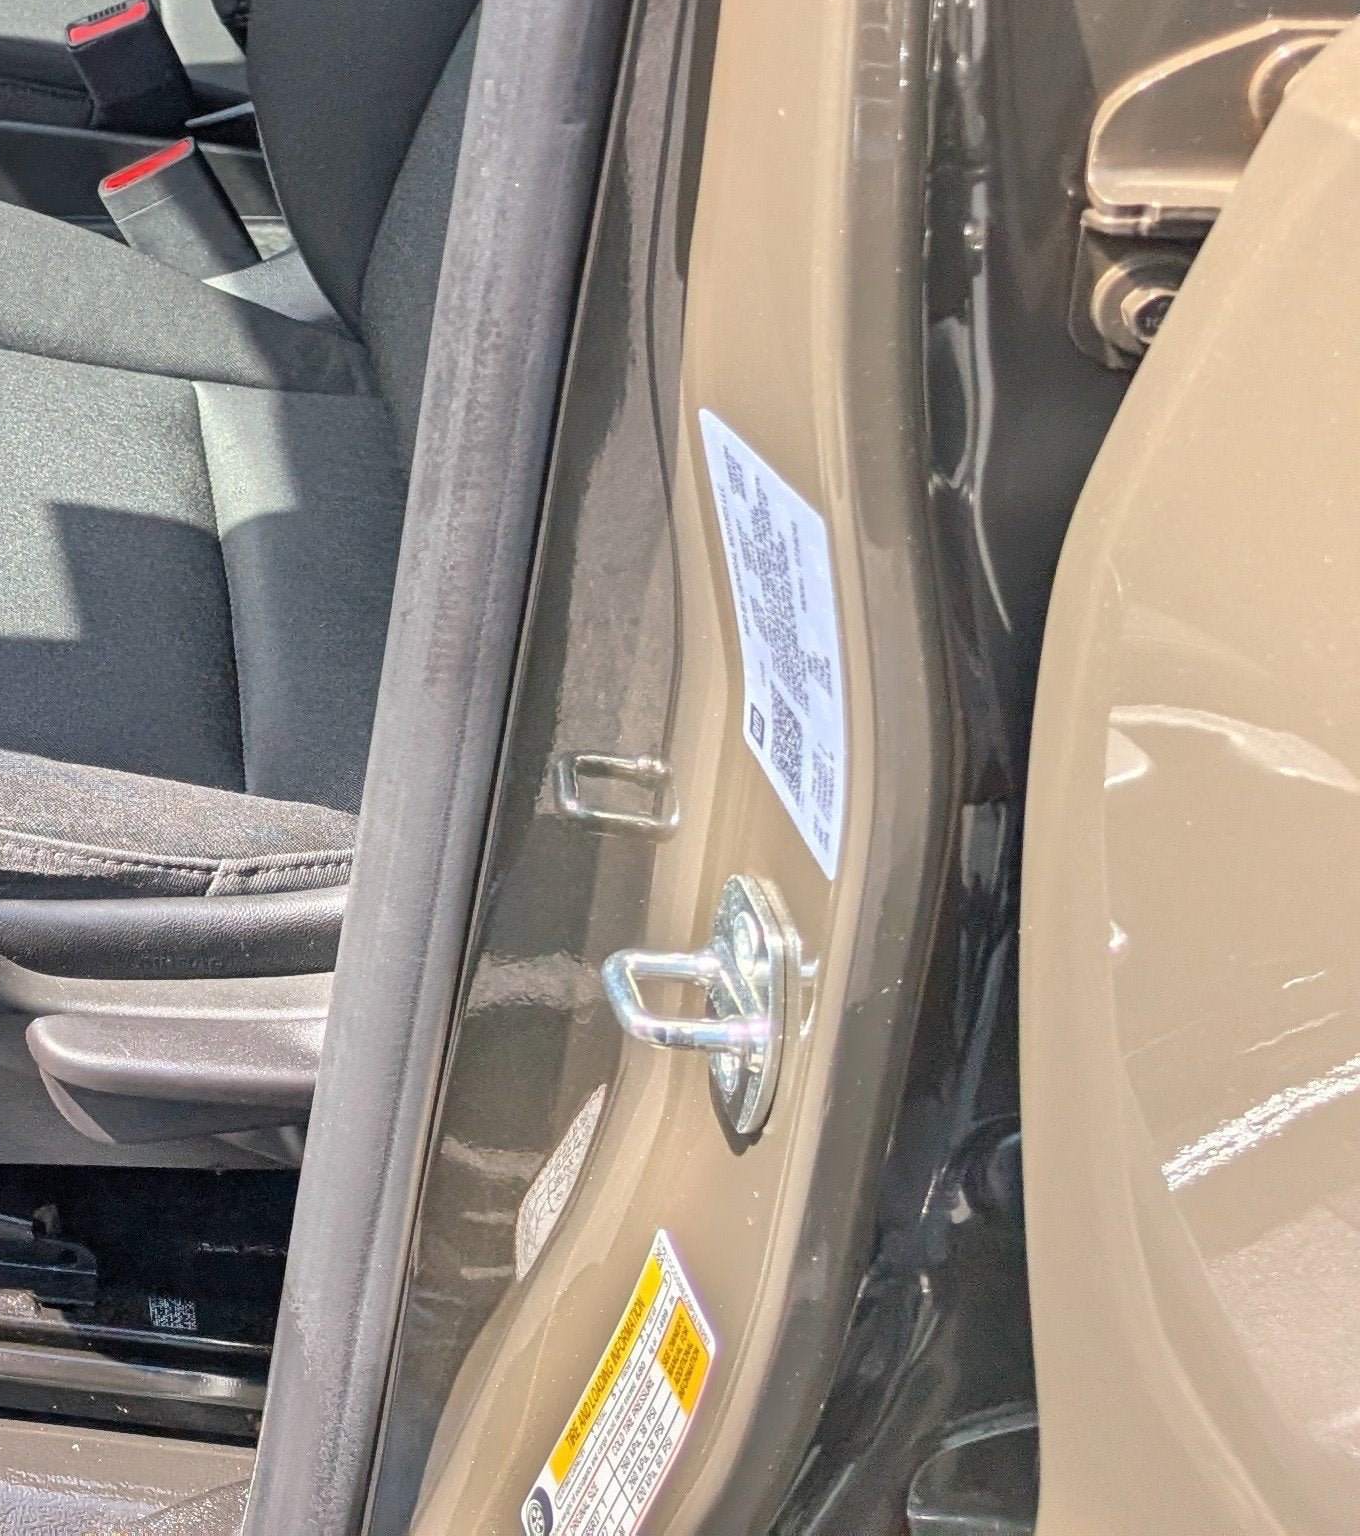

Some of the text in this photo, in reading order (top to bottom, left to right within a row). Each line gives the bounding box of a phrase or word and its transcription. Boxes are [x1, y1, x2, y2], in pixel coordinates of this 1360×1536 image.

[564, 1295, 645, 1451] TIRE AND LOADING INFORMATION
[634, 1360, 646, 1382] 680
[638, 1422, 647, 1439] 38
[646, 1406, 656, 1425] PSI
[653, 1421, 664, 1441] PSI
[661, 1436, 672, 1456] PSI
